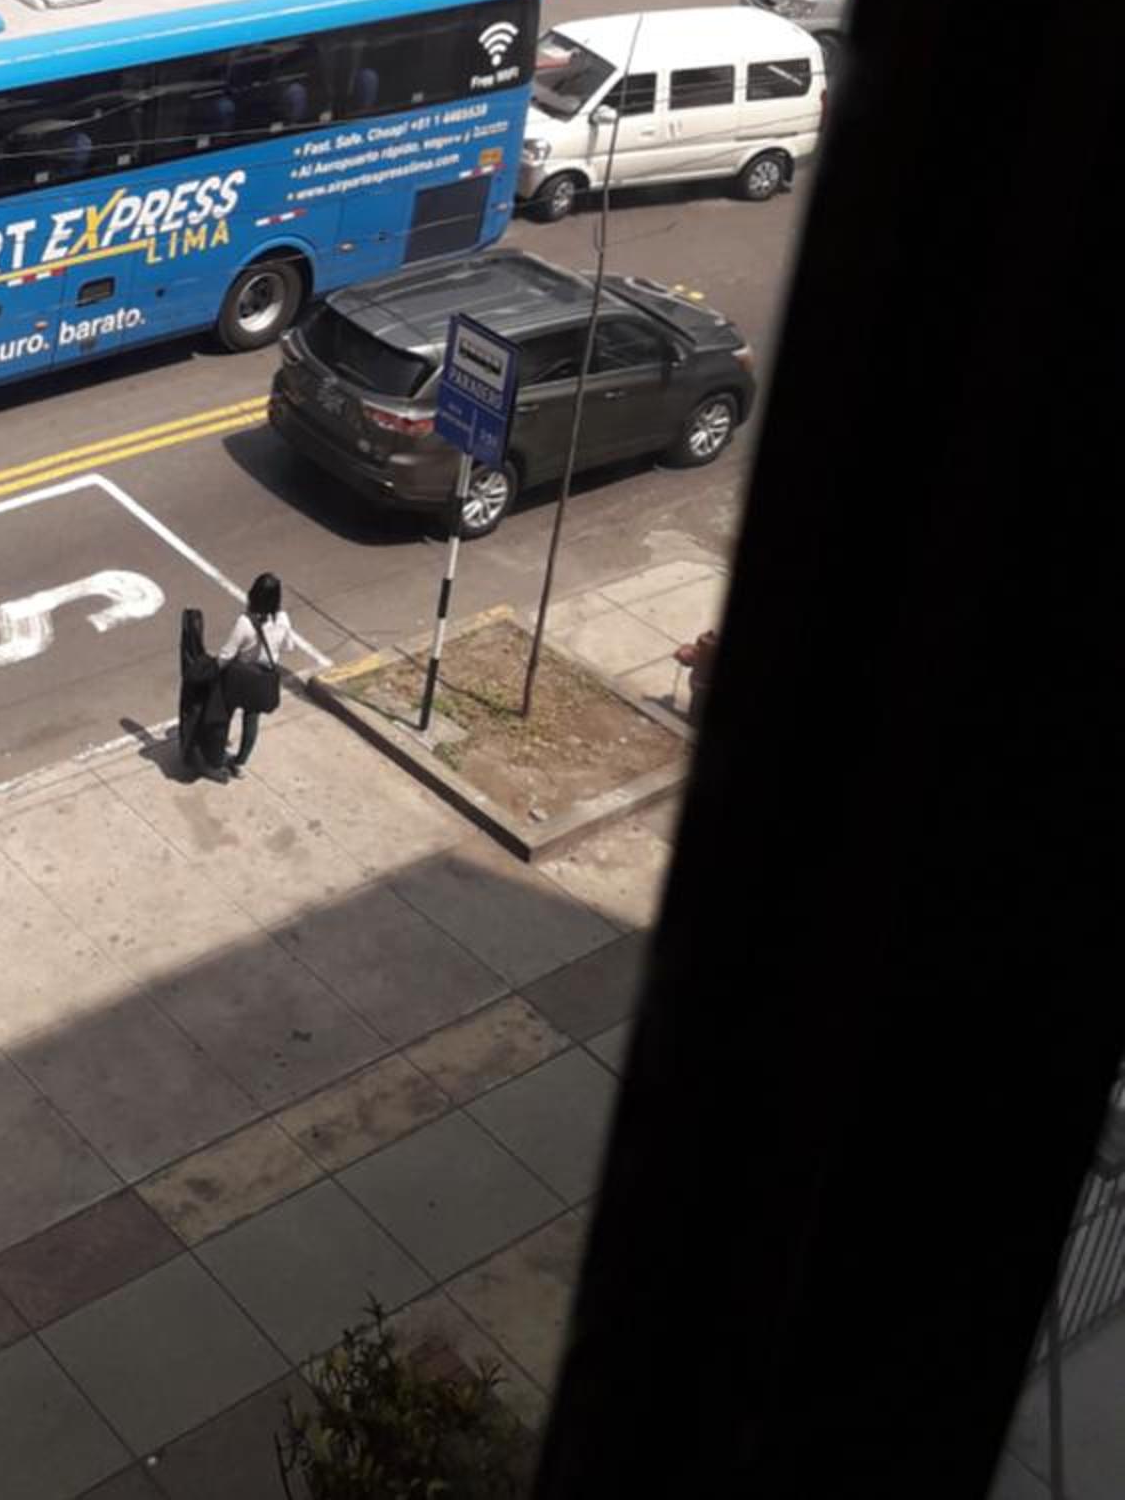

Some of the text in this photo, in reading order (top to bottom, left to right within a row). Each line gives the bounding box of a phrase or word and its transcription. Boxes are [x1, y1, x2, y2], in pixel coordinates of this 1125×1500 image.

[42, 169, 246, 264] EXPRESS
[145, 219, 231, 266] LIMA
[58, 305, 147, 347] barato.
